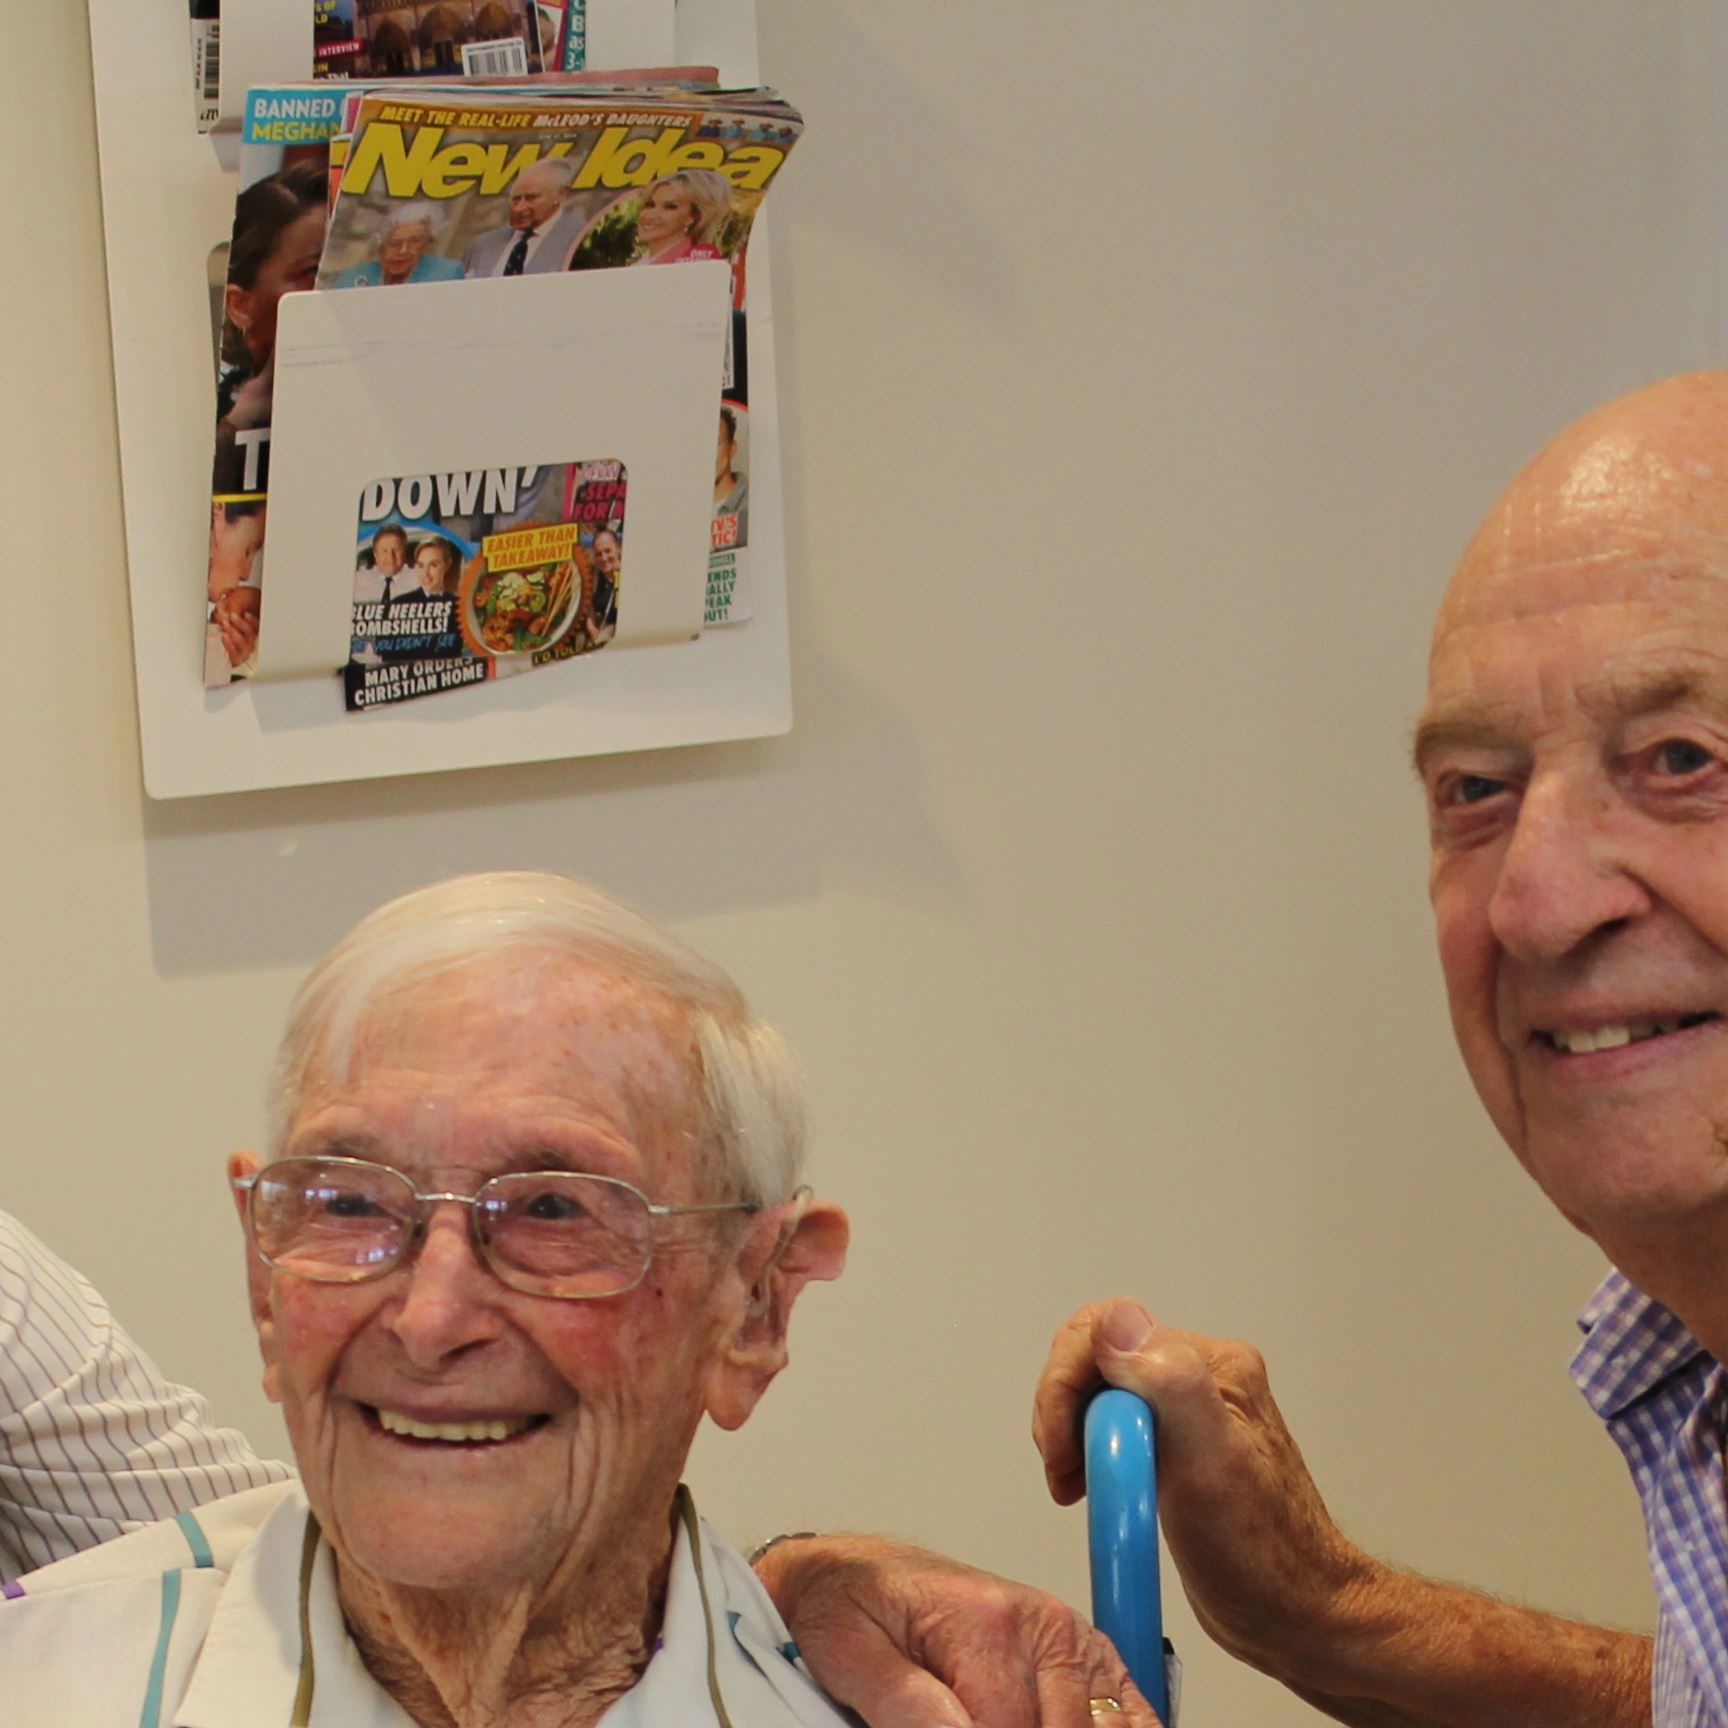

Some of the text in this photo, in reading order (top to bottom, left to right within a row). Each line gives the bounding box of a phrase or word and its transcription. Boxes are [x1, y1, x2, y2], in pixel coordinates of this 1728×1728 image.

[254, 98, 335, 119] BANNED
[380, 105, 424, 123] MEET
[426, 110, 456, 125] THE
[458, 112, 532, 128] REAL-LIFE
[606, 113, 693, 127] DAUGHTERS
[341, 122, 784, 198] New Idea
[487, 525, 576, 554] EASIER THAN
[492, 544, 571, 570] TAKEAWAY!
[705, 579, 735, 596] ALLY
[388, 601, 452, 620] HEELERS
[354, 663, 484, 706] CHRISTIAN HOME
[364, 664, 409, 687] MARY
